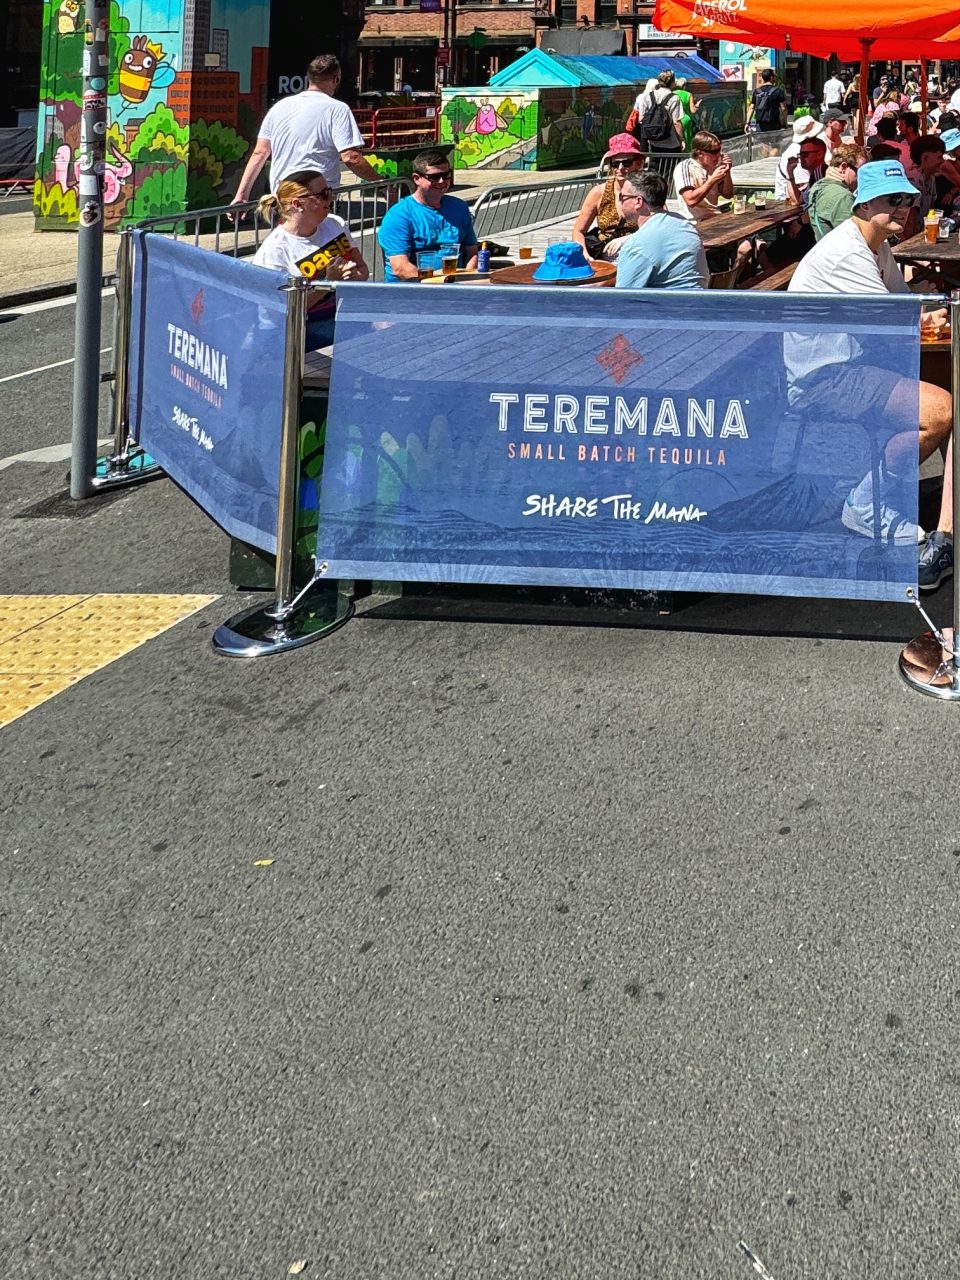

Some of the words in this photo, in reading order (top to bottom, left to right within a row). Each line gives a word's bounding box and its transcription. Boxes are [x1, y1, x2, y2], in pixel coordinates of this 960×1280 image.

[299, 236, 353, 278] oasis
[167, 323, 228, 390] TEREMANA
[172, 405, 191, 432] SHARE
[489, 392, 749, 439] TEREMANA
[507, 442, 566, 461] SMALL
[578, 444, 636, 462] BATCH
[648, 447, 726, 466] TEQUILA
[522, 493, 598, 518] SHARE
[600, 493, 640, 520] THE
[644, 501, 708, 524] MANA
